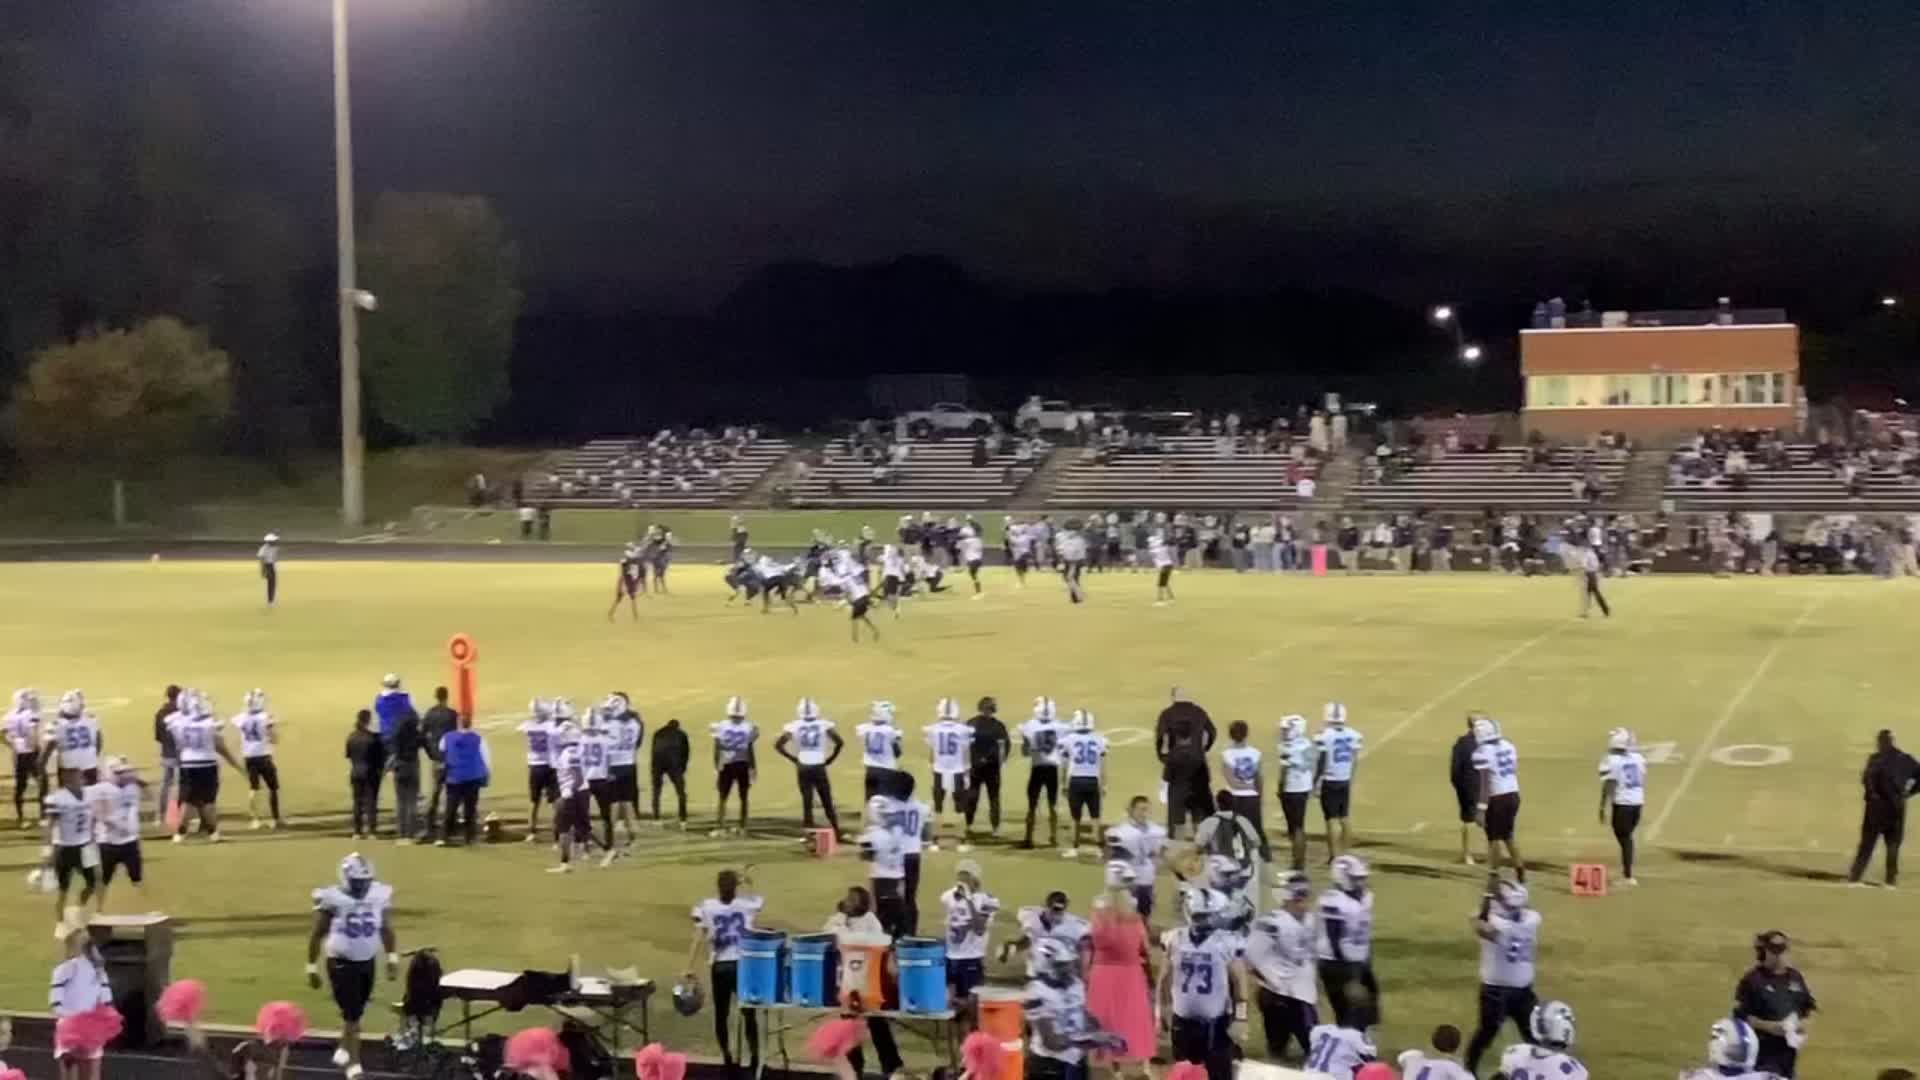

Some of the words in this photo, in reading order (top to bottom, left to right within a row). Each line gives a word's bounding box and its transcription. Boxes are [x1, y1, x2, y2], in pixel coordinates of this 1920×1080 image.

[939, 732, 958, 756] 16
[1074, 740, 1098, 765] 36
[1575, 868, 1602, 891] 40
[1181, 961, 1213, 994] 73
